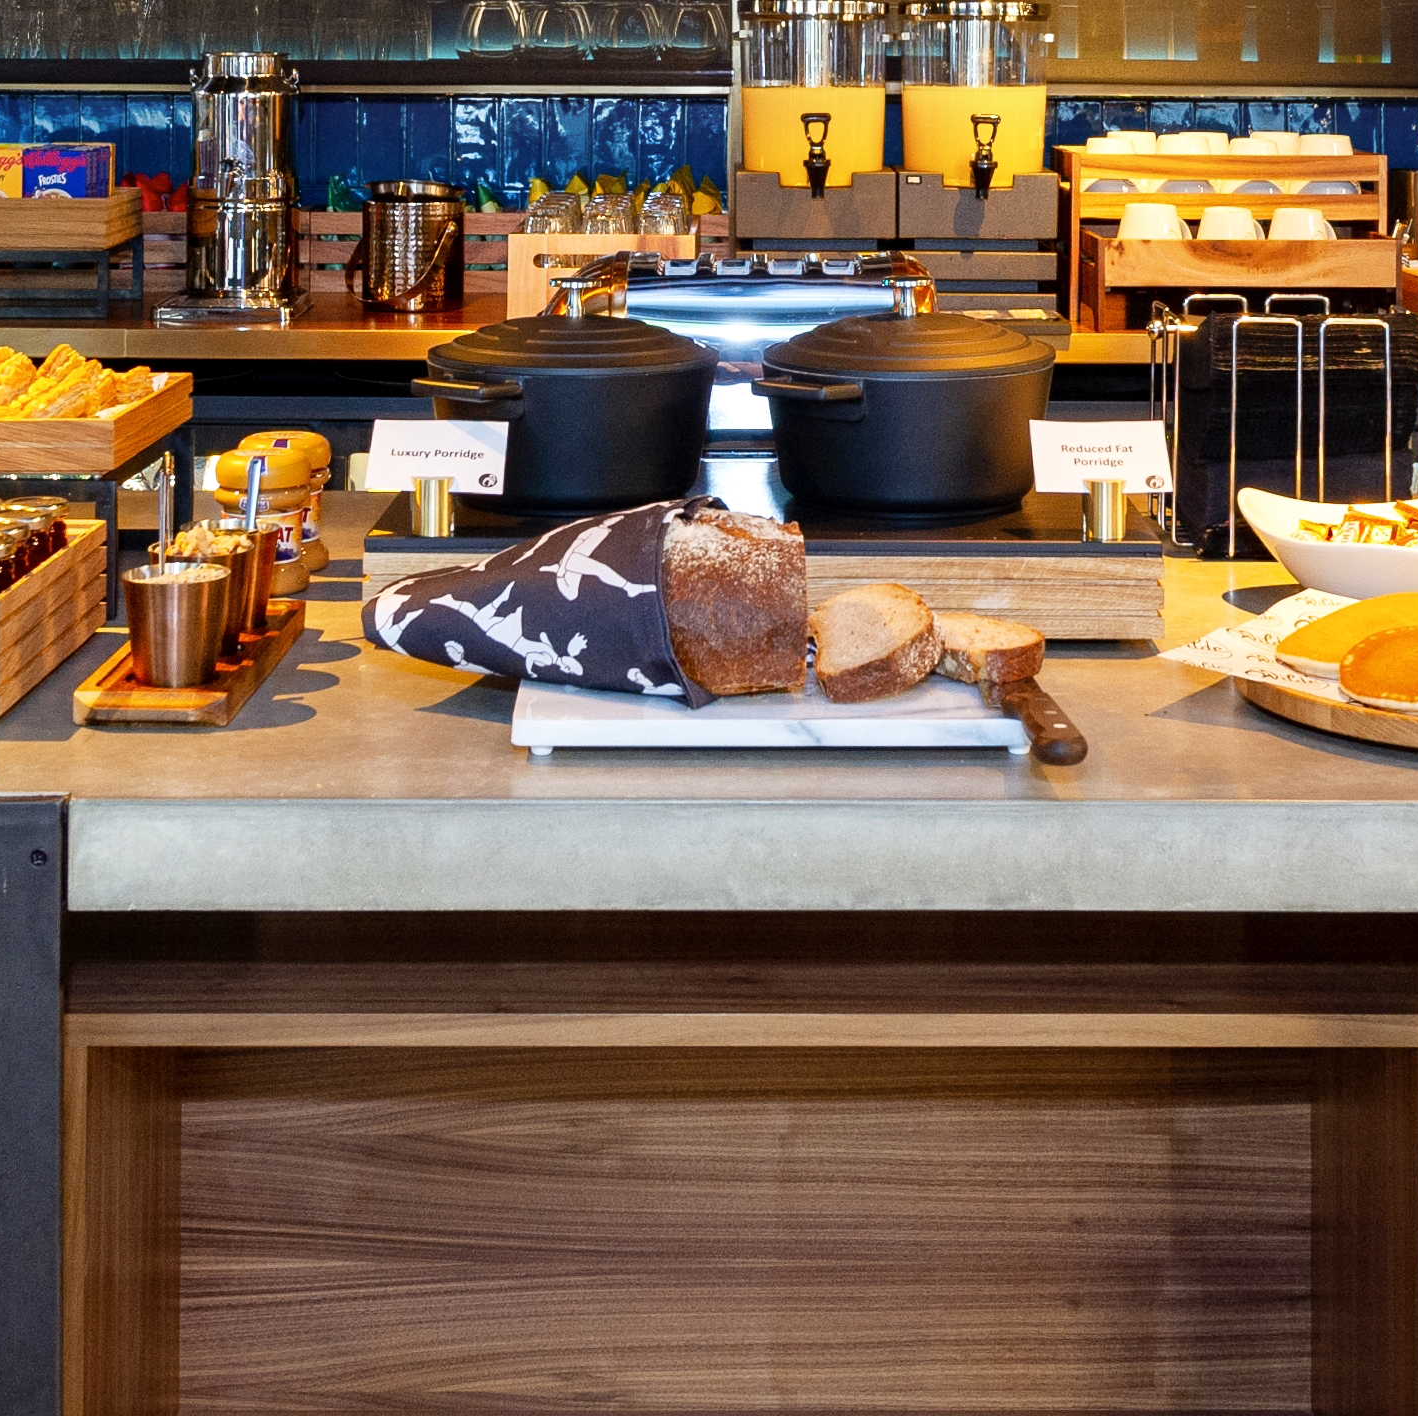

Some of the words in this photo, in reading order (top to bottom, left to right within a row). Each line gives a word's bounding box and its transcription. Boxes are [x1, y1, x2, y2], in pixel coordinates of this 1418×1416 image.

[1061, 444, 1112, 453] Reduced
[1115, 444, 1133, 453] Fat
[391, 448, 431, 459] Luxury
[434, 449, 485, 460] Porridge
[1074, 457, 1124, 467] Porridge
